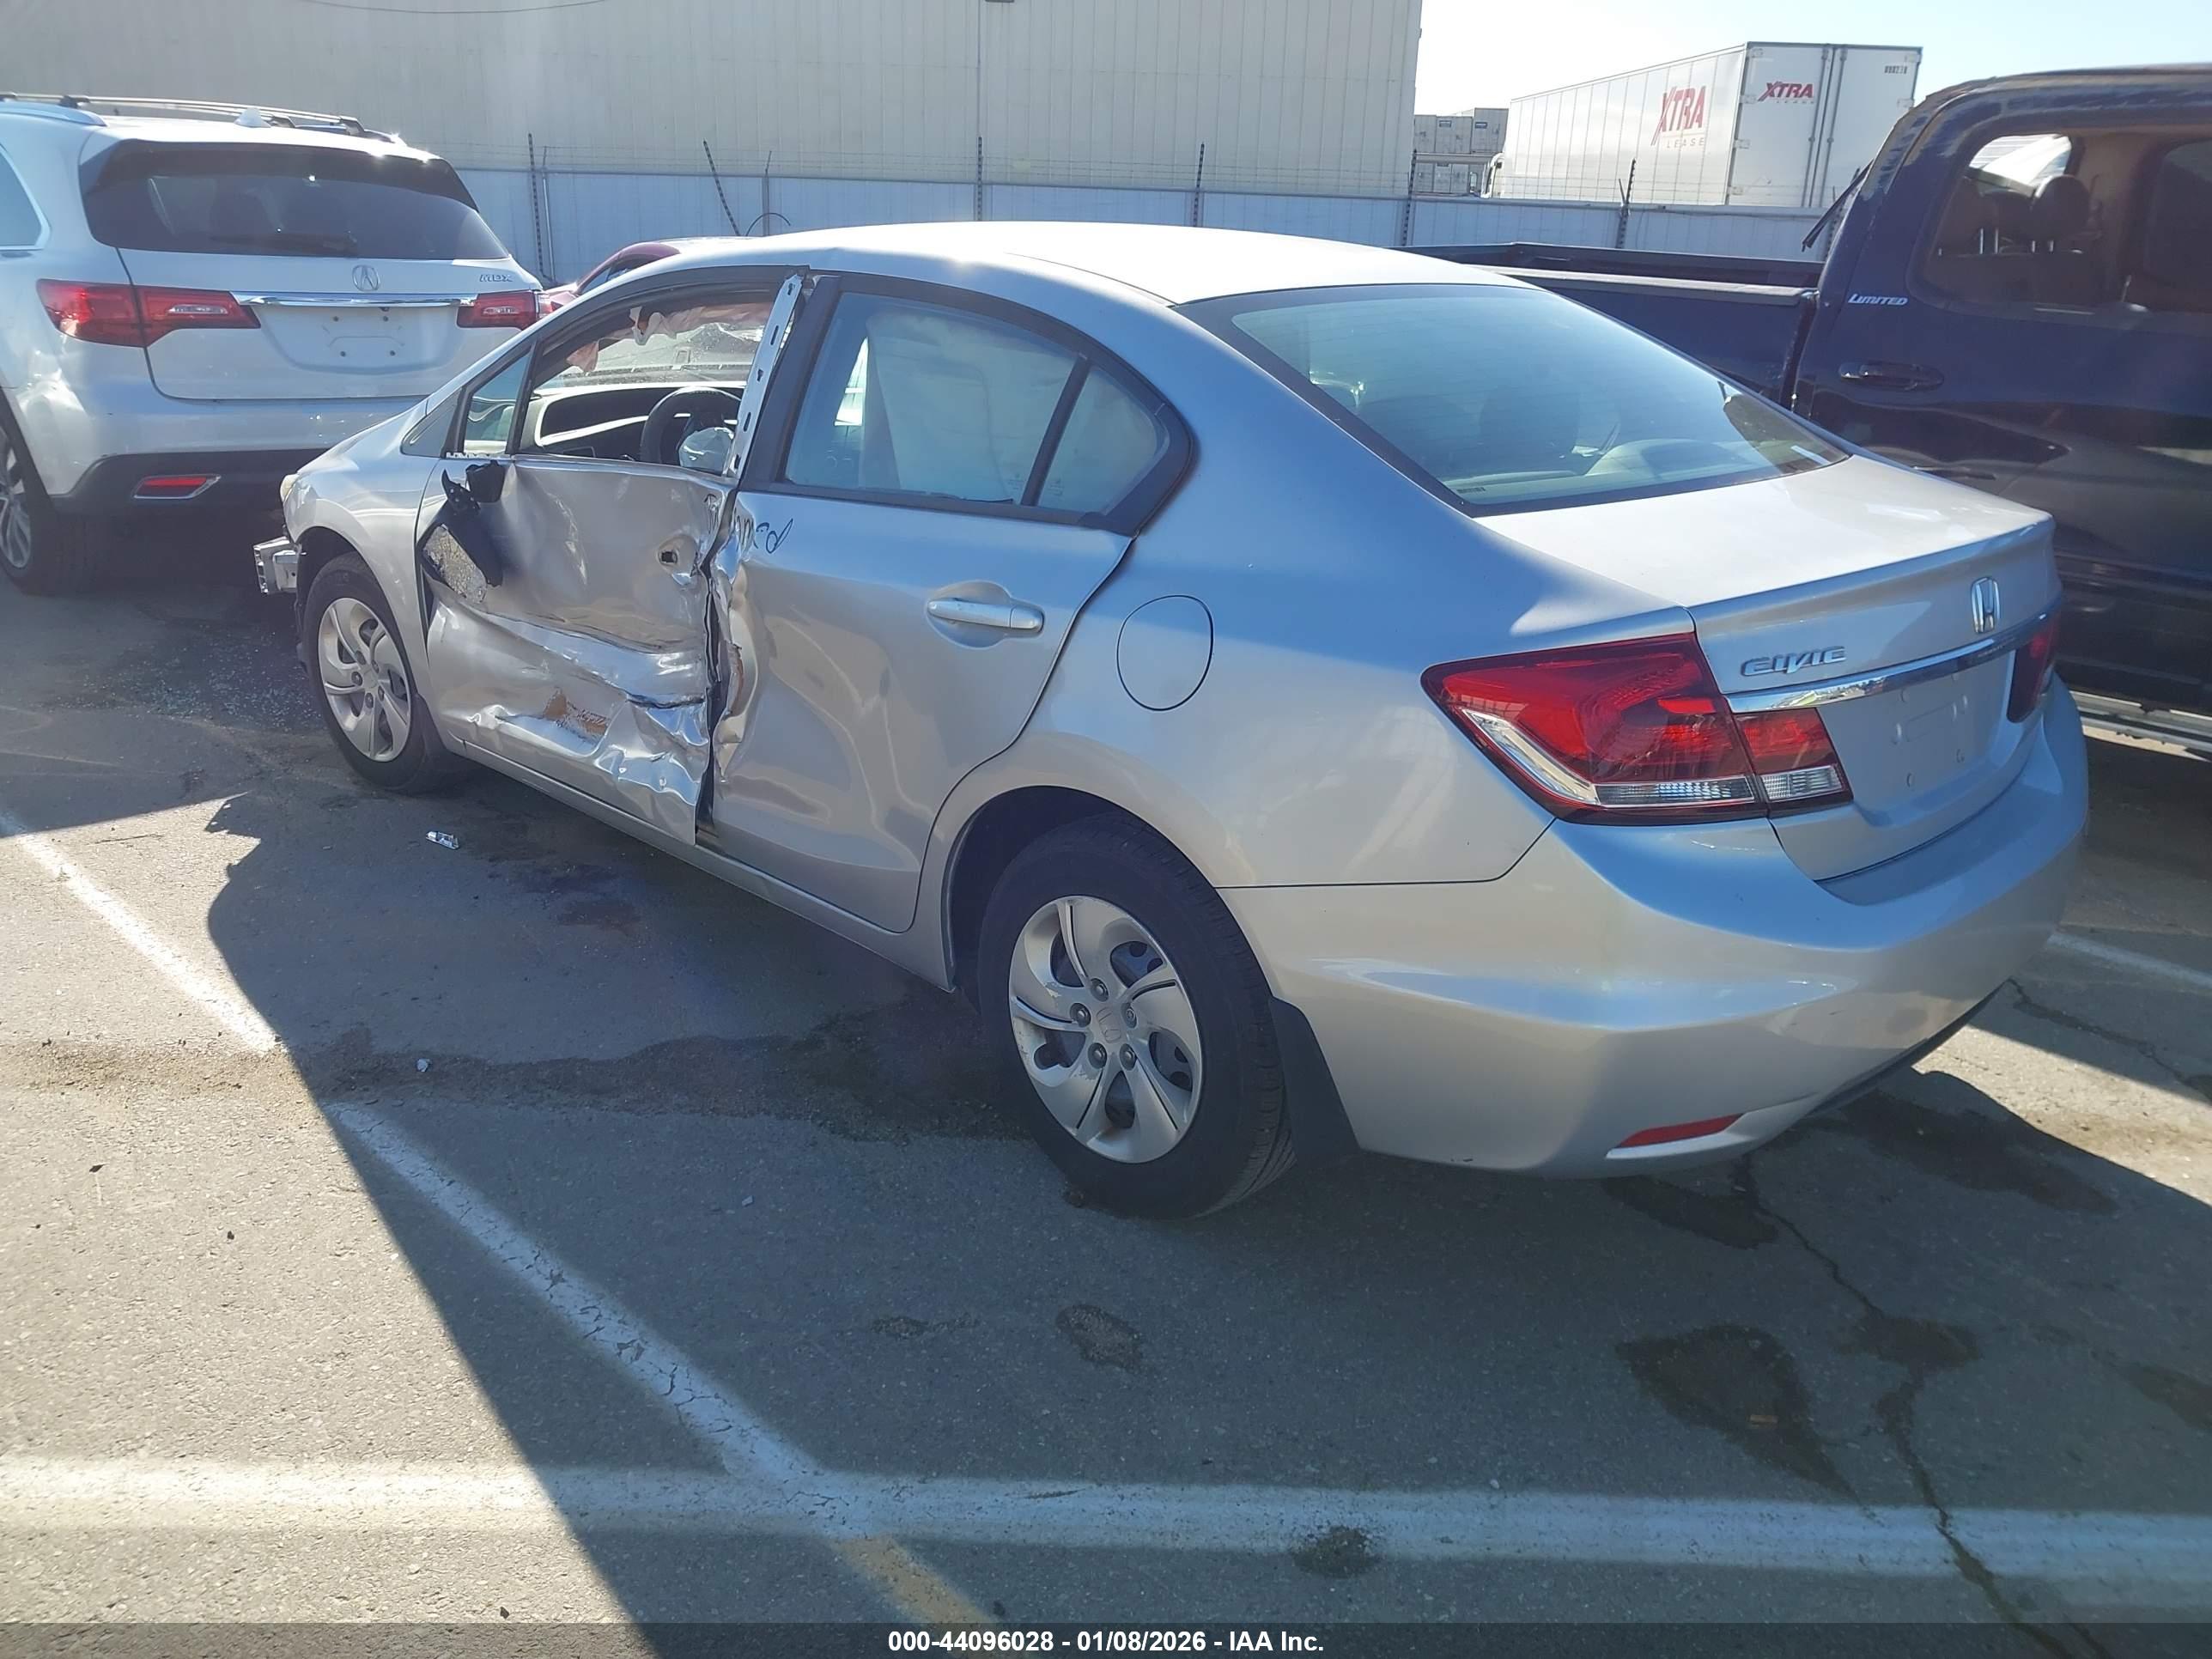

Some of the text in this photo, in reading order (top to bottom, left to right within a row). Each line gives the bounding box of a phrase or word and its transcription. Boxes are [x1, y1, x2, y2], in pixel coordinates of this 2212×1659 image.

[1758, 81, 1814, 101] XTRA
[1650, 86, 1706, 146] XTRA
[1666, 137, 1705, 149] LEASE
[479, 274, 514, 283] MDX
[1740, 645, 1846, 677] CIVIC
